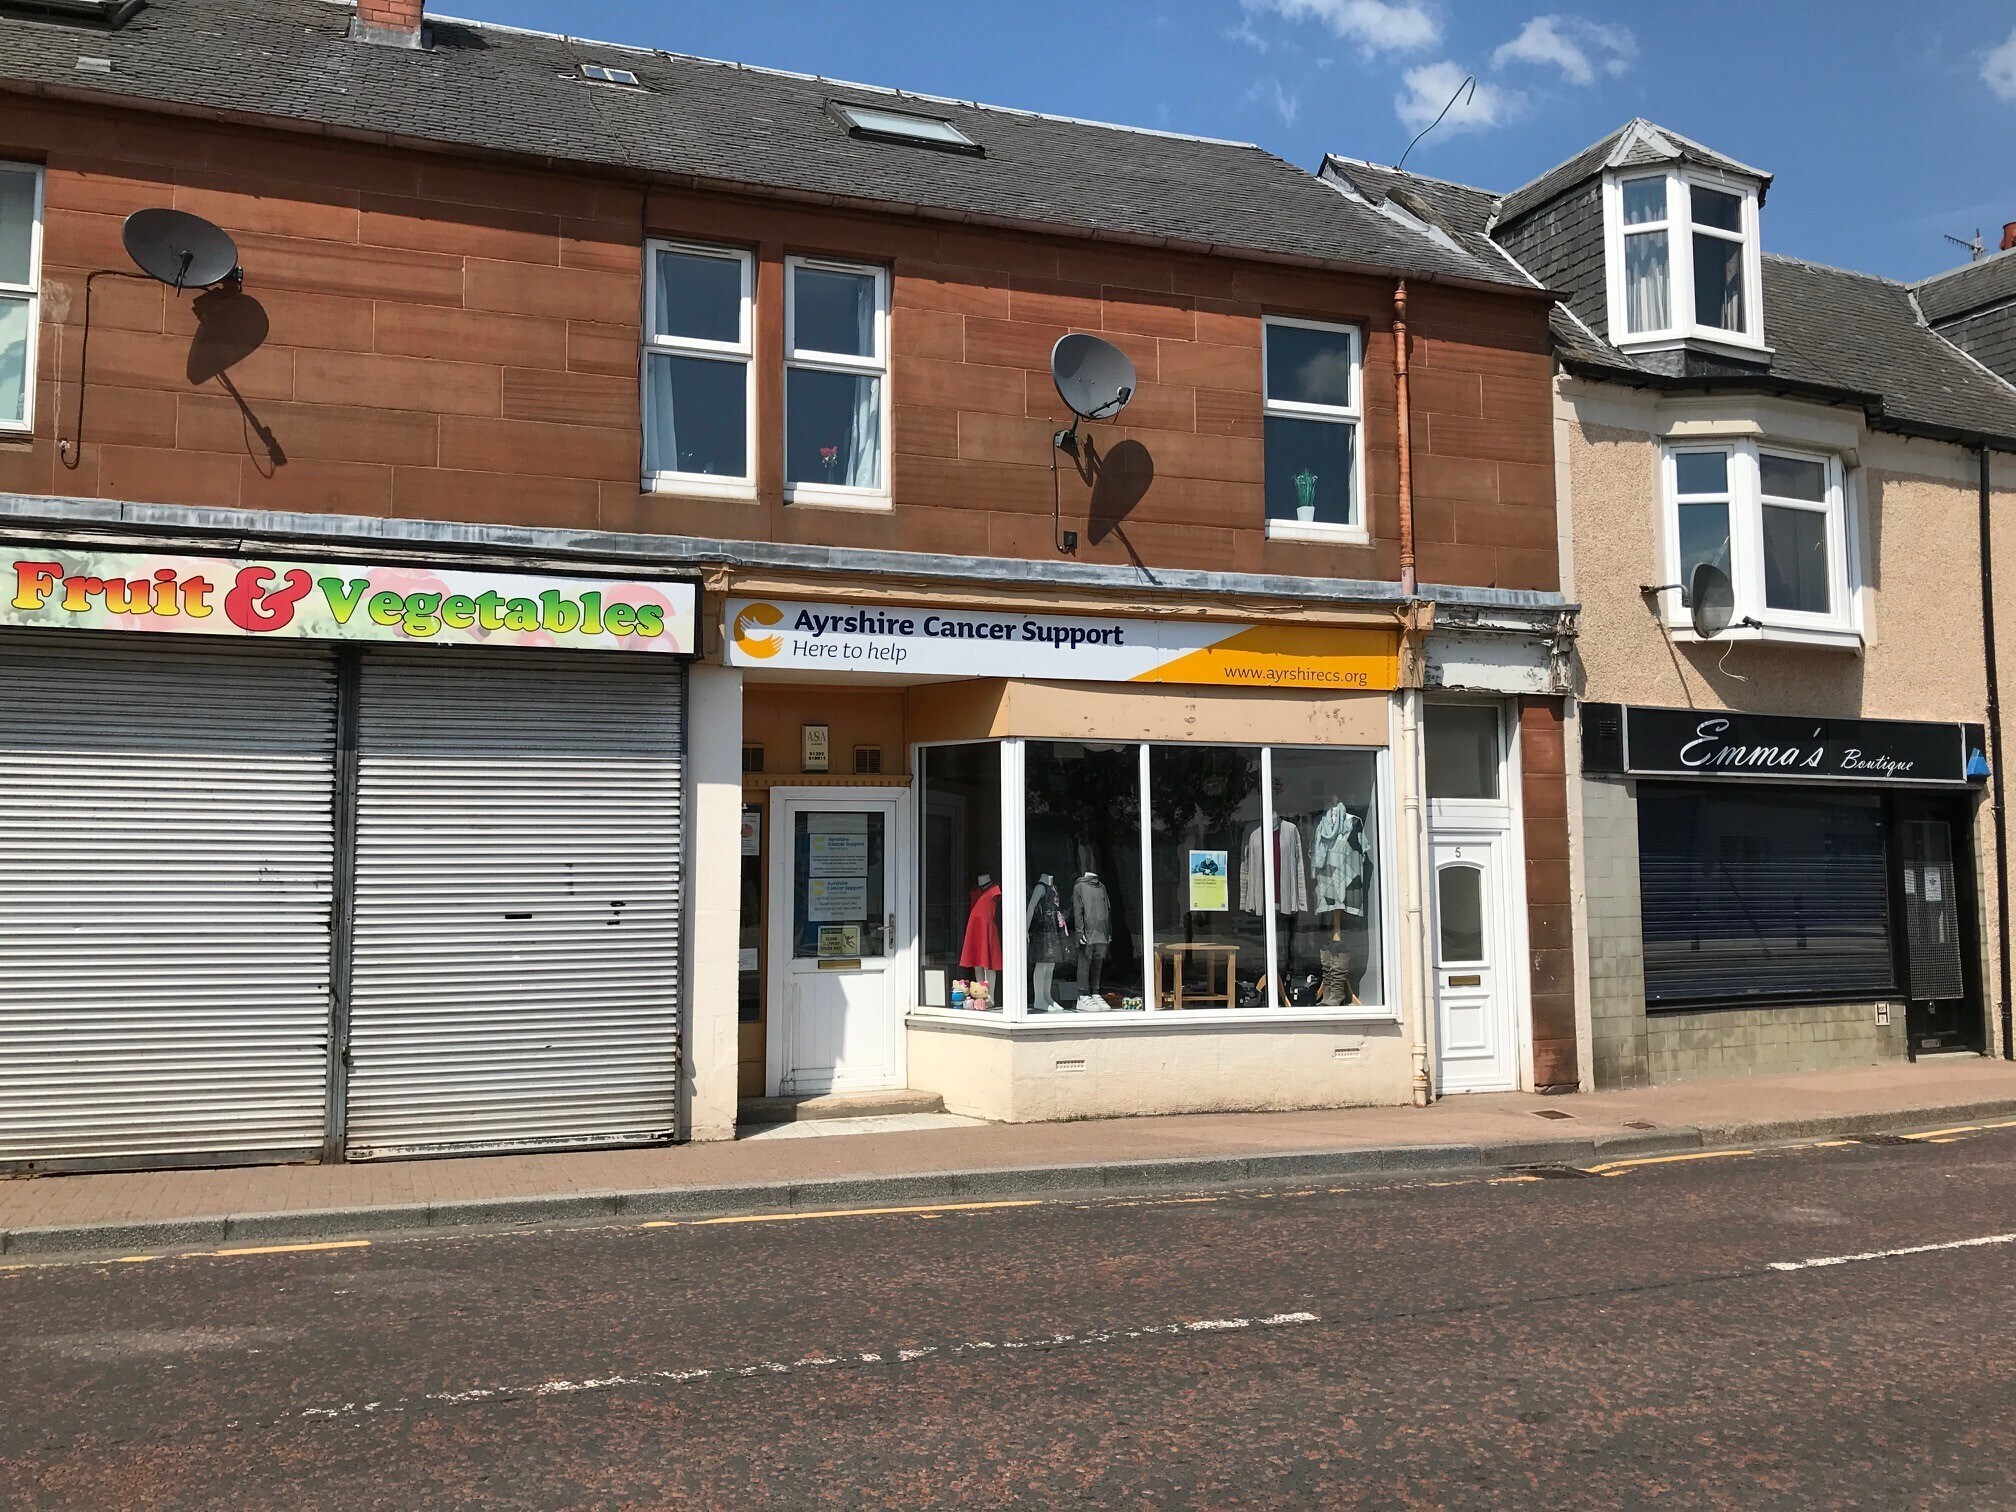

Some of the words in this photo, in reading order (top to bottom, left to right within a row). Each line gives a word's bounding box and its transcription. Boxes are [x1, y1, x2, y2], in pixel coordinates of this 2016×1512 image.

[11, 561, 214, 618] Fruit
[225, 566, 312, 631] &
[317, 577, 665, 637] Vegetables
[794, 609, 914, 637] Ayrshire
[923, 616, 1017, 640] Cancer
[1022, 621, 1124, 649] Support
[793, 640, 838, 657] Here
[843, 642, 863, 659] to
[868, 642, 907, 665] help
[1224, 667, 1367, 687] www.ayrshirecs.org
[807, 731, 826, 742] ASA
[1680, 718, 1824, 767] Emma's
[1840, 749, 1914, 777] Boutique
[1455, 846, 1461, 858] 5
